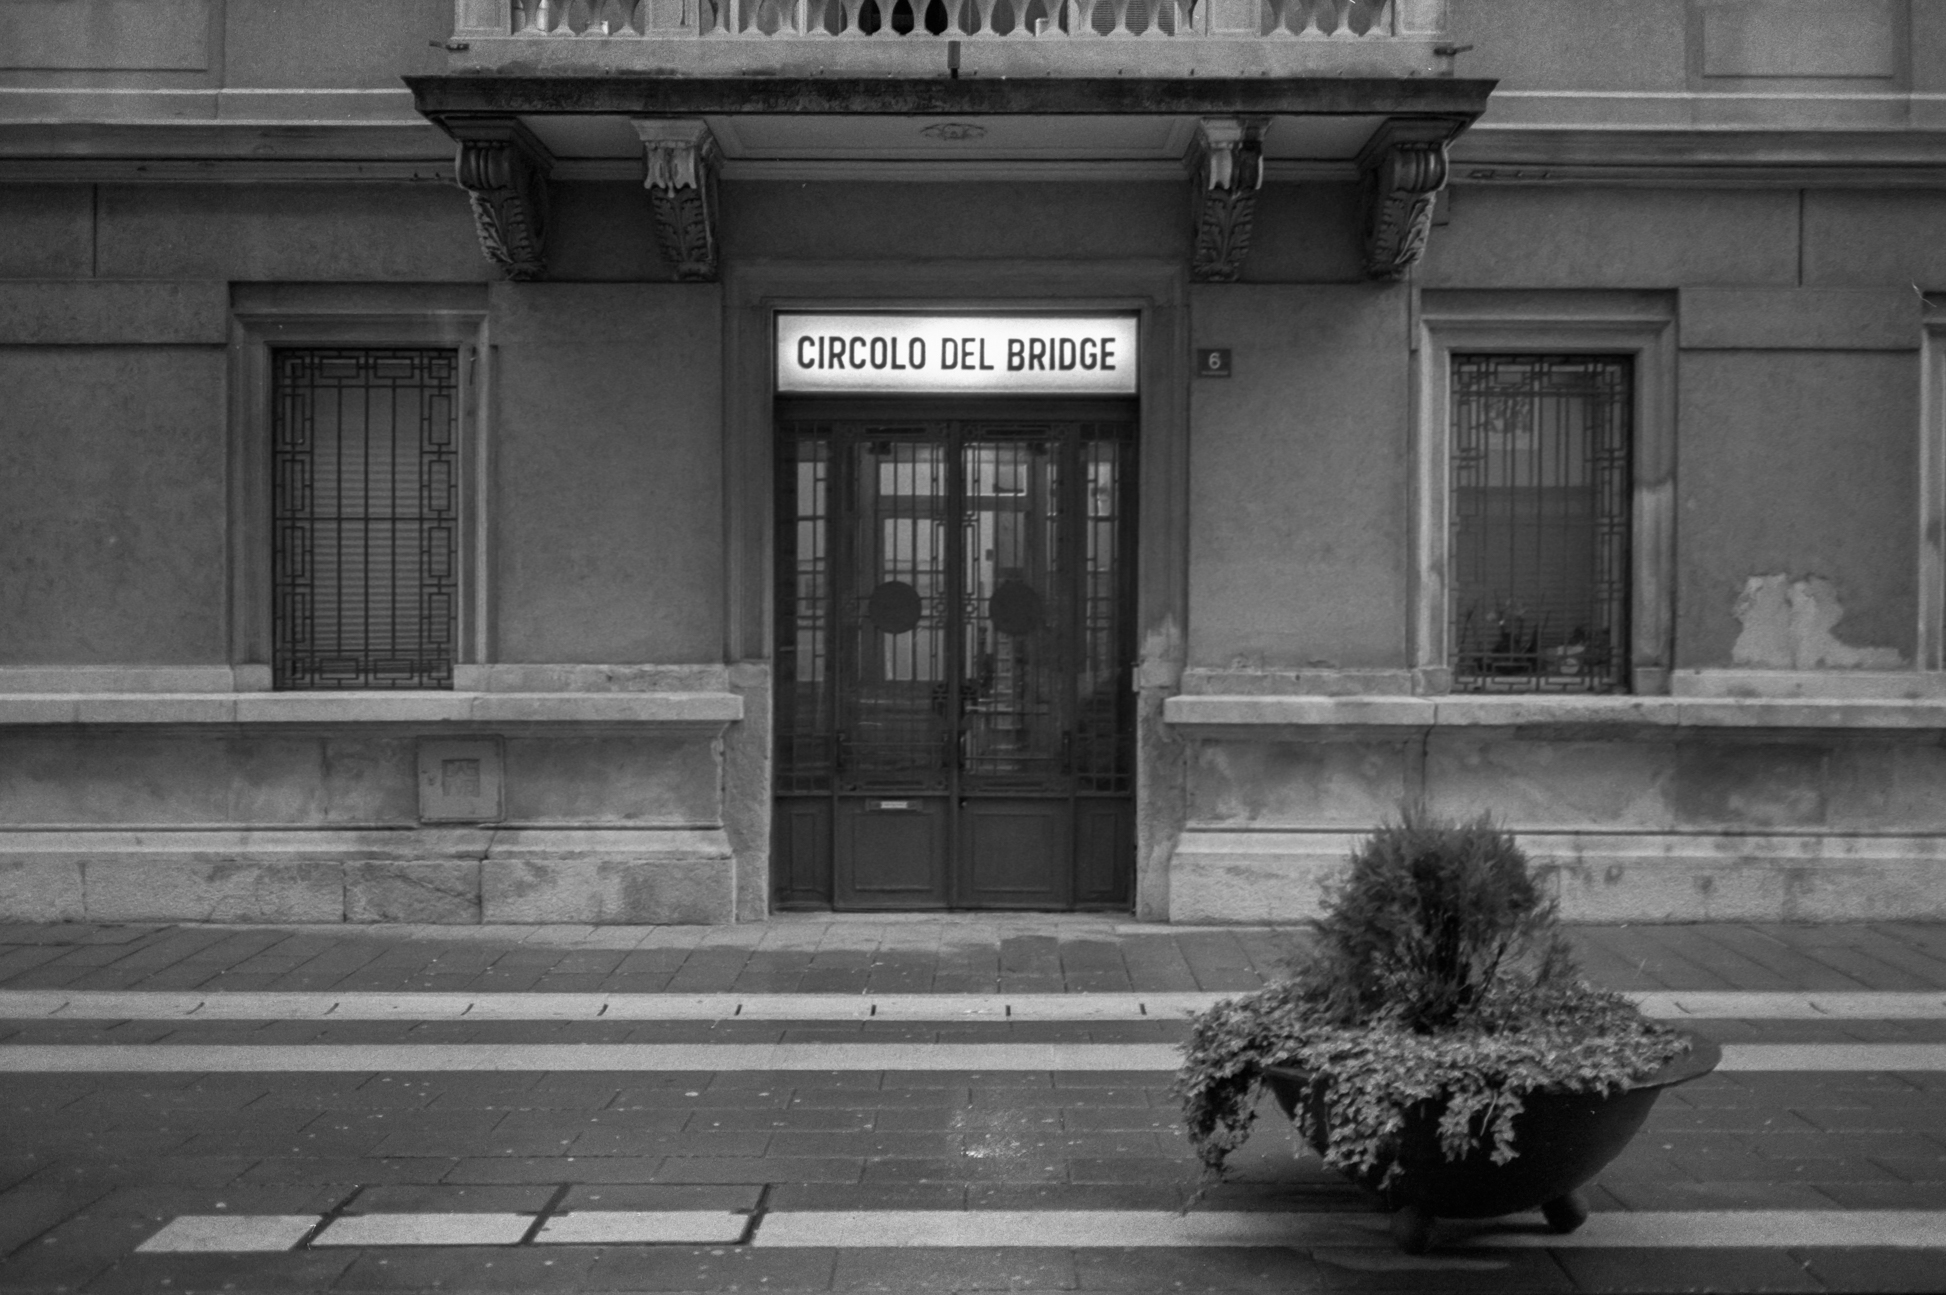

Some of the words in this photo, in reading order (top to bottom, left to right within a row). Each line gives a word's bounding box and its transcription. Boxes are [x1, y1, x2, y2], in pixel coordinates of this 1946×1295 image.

[797, 335, 926, 370] CIRCOLO
[941, 337, 995, 371] DEL
[1007, 337, 1117, 371] BRIDGE
[1209, 352, 1221, 369] 6
